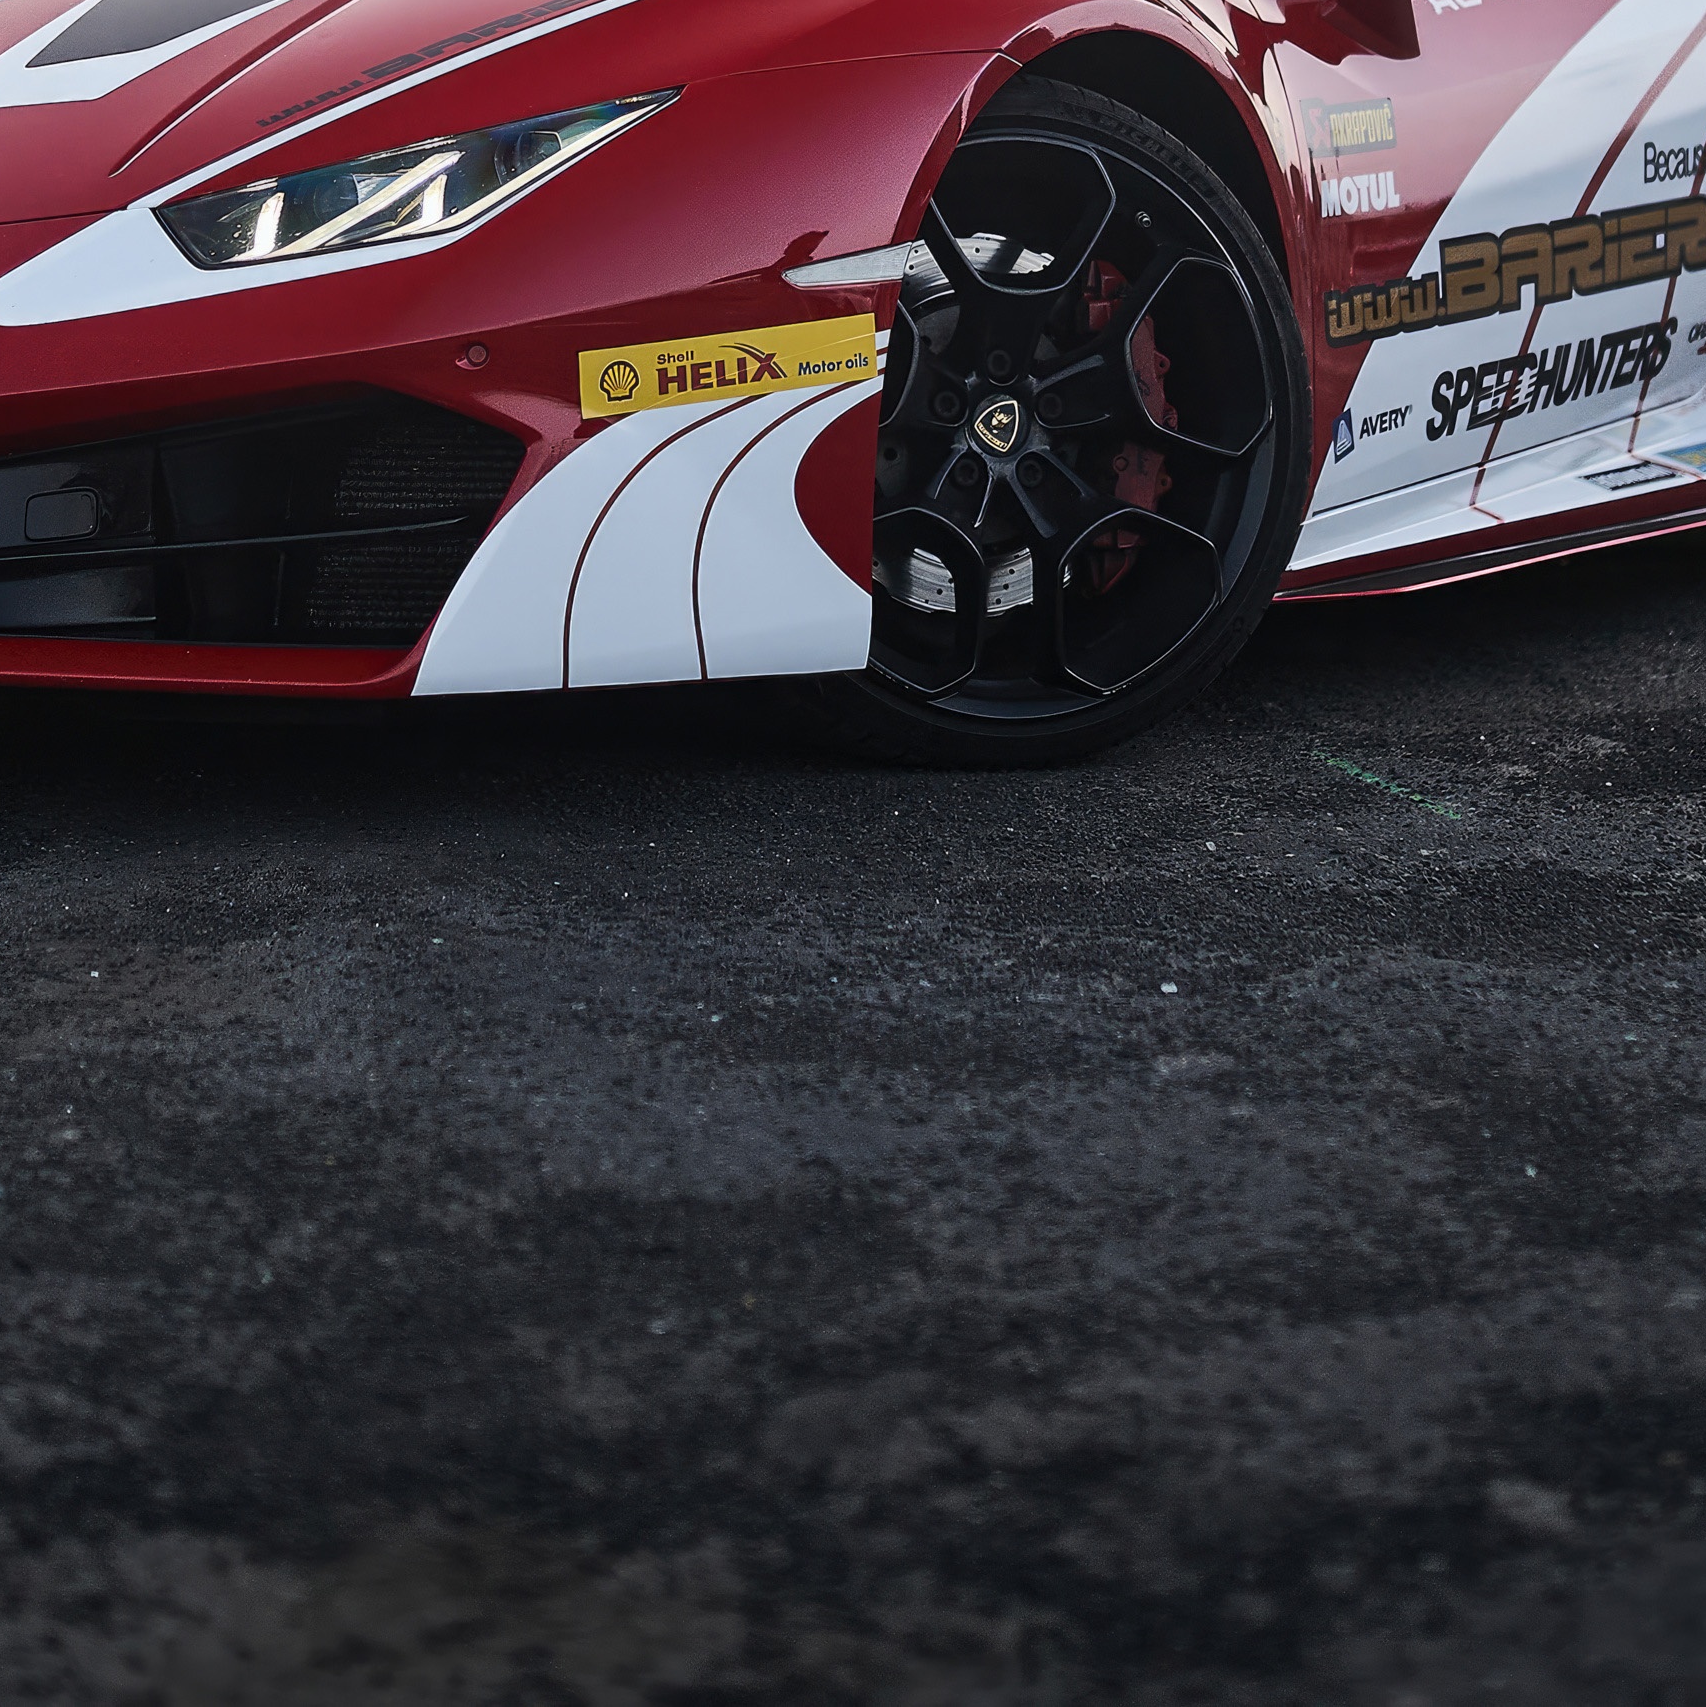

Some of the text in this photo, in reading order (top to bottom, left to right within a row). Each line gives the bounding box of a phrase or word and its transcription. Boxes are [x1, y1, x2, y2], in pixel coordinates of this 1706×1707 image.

[1321, 171, 1400, 218] MOTUL
[656, 349, 869, 396] HELIX Motor oils
[657, 350, 694, 365] Shell
[1426, 317, 1678, 442] SPEEDHUNTERS
[1359, 404, 1411, 440] AVERY
